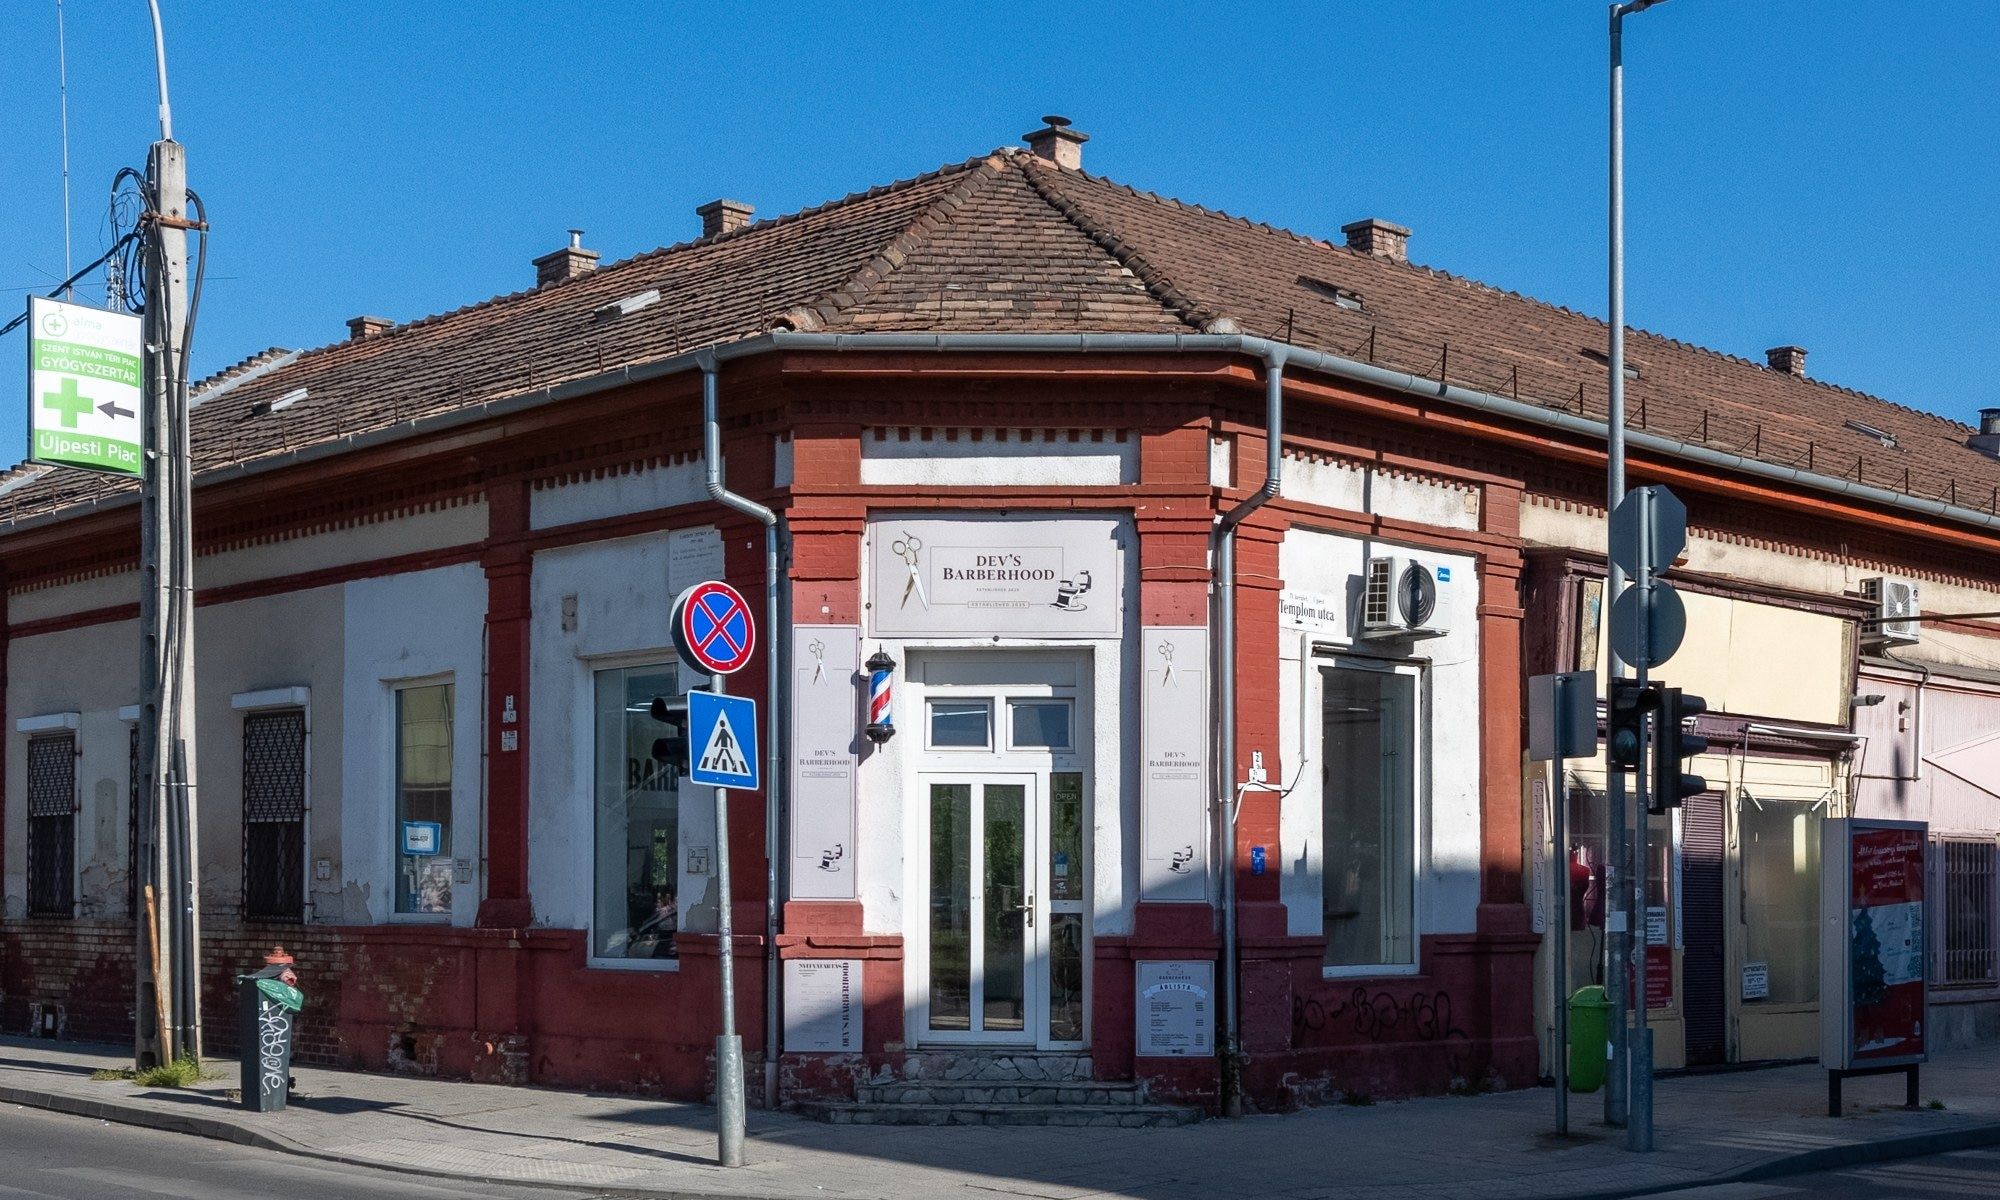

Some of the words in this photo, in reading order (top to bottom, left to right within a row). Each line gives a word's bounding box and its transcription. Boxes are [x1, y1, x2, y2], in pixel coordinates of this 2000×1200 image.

[41, 343, 70, 354] SZENT
[72, 345, 103, 360] ISTVÁN
[105, 351, 121, 364] TÉRI
[122, 356, 137, 368] PIAC
[41, 356, 137, 383] GYÓGYSZERTÁR
[39, 432, 102, 458] Újpesti
[108, 443, 137, 464] Piac
[976, 553, 1022, 567] DEV'S
[943, 567, 1055, 581] BARBERHOOD
[1279, 598, 1316, 619] Templom
[1317, 608, 1335, 622] utca
[799, 758, 850, 766] BARBERHOOD
[1149, 759, 1200, 767] BARBERHOOD
[1055, 792, 1078, 801] OPEN
